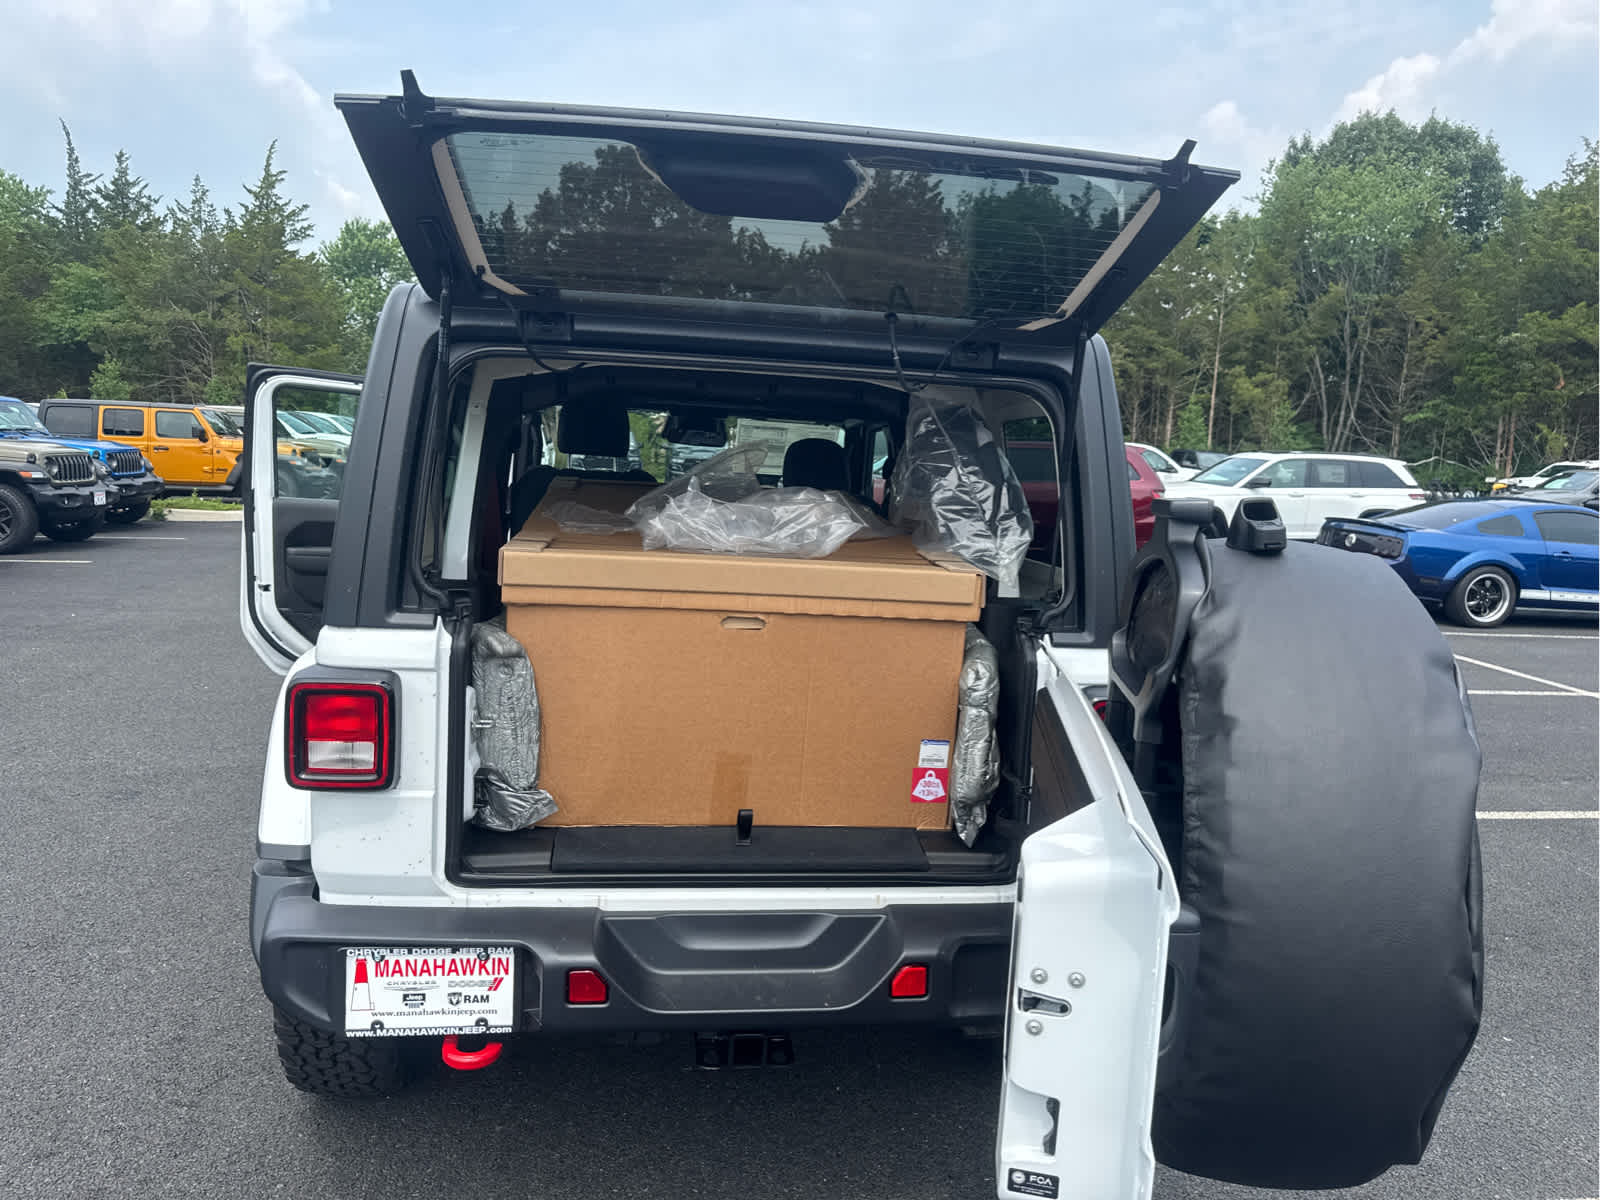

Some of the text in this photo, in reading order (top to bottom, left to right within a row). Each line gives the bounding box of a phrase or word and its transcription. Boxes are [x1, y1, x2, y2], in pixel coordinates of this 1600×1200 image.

[346, 947, 514, 957] CHRYSLER DODGE JEEP RAM
[375, 957, 510, 978] MANAHAWKIN
[464, 994, 490, 1004] RAM
[371, 1007, 498, 1018] www.manahawkinjeep.com
[346, 1026, 512, 1038] www.MANAHAWKINJEEP.com
[1029, 1175, 1053, 1186] FCA
